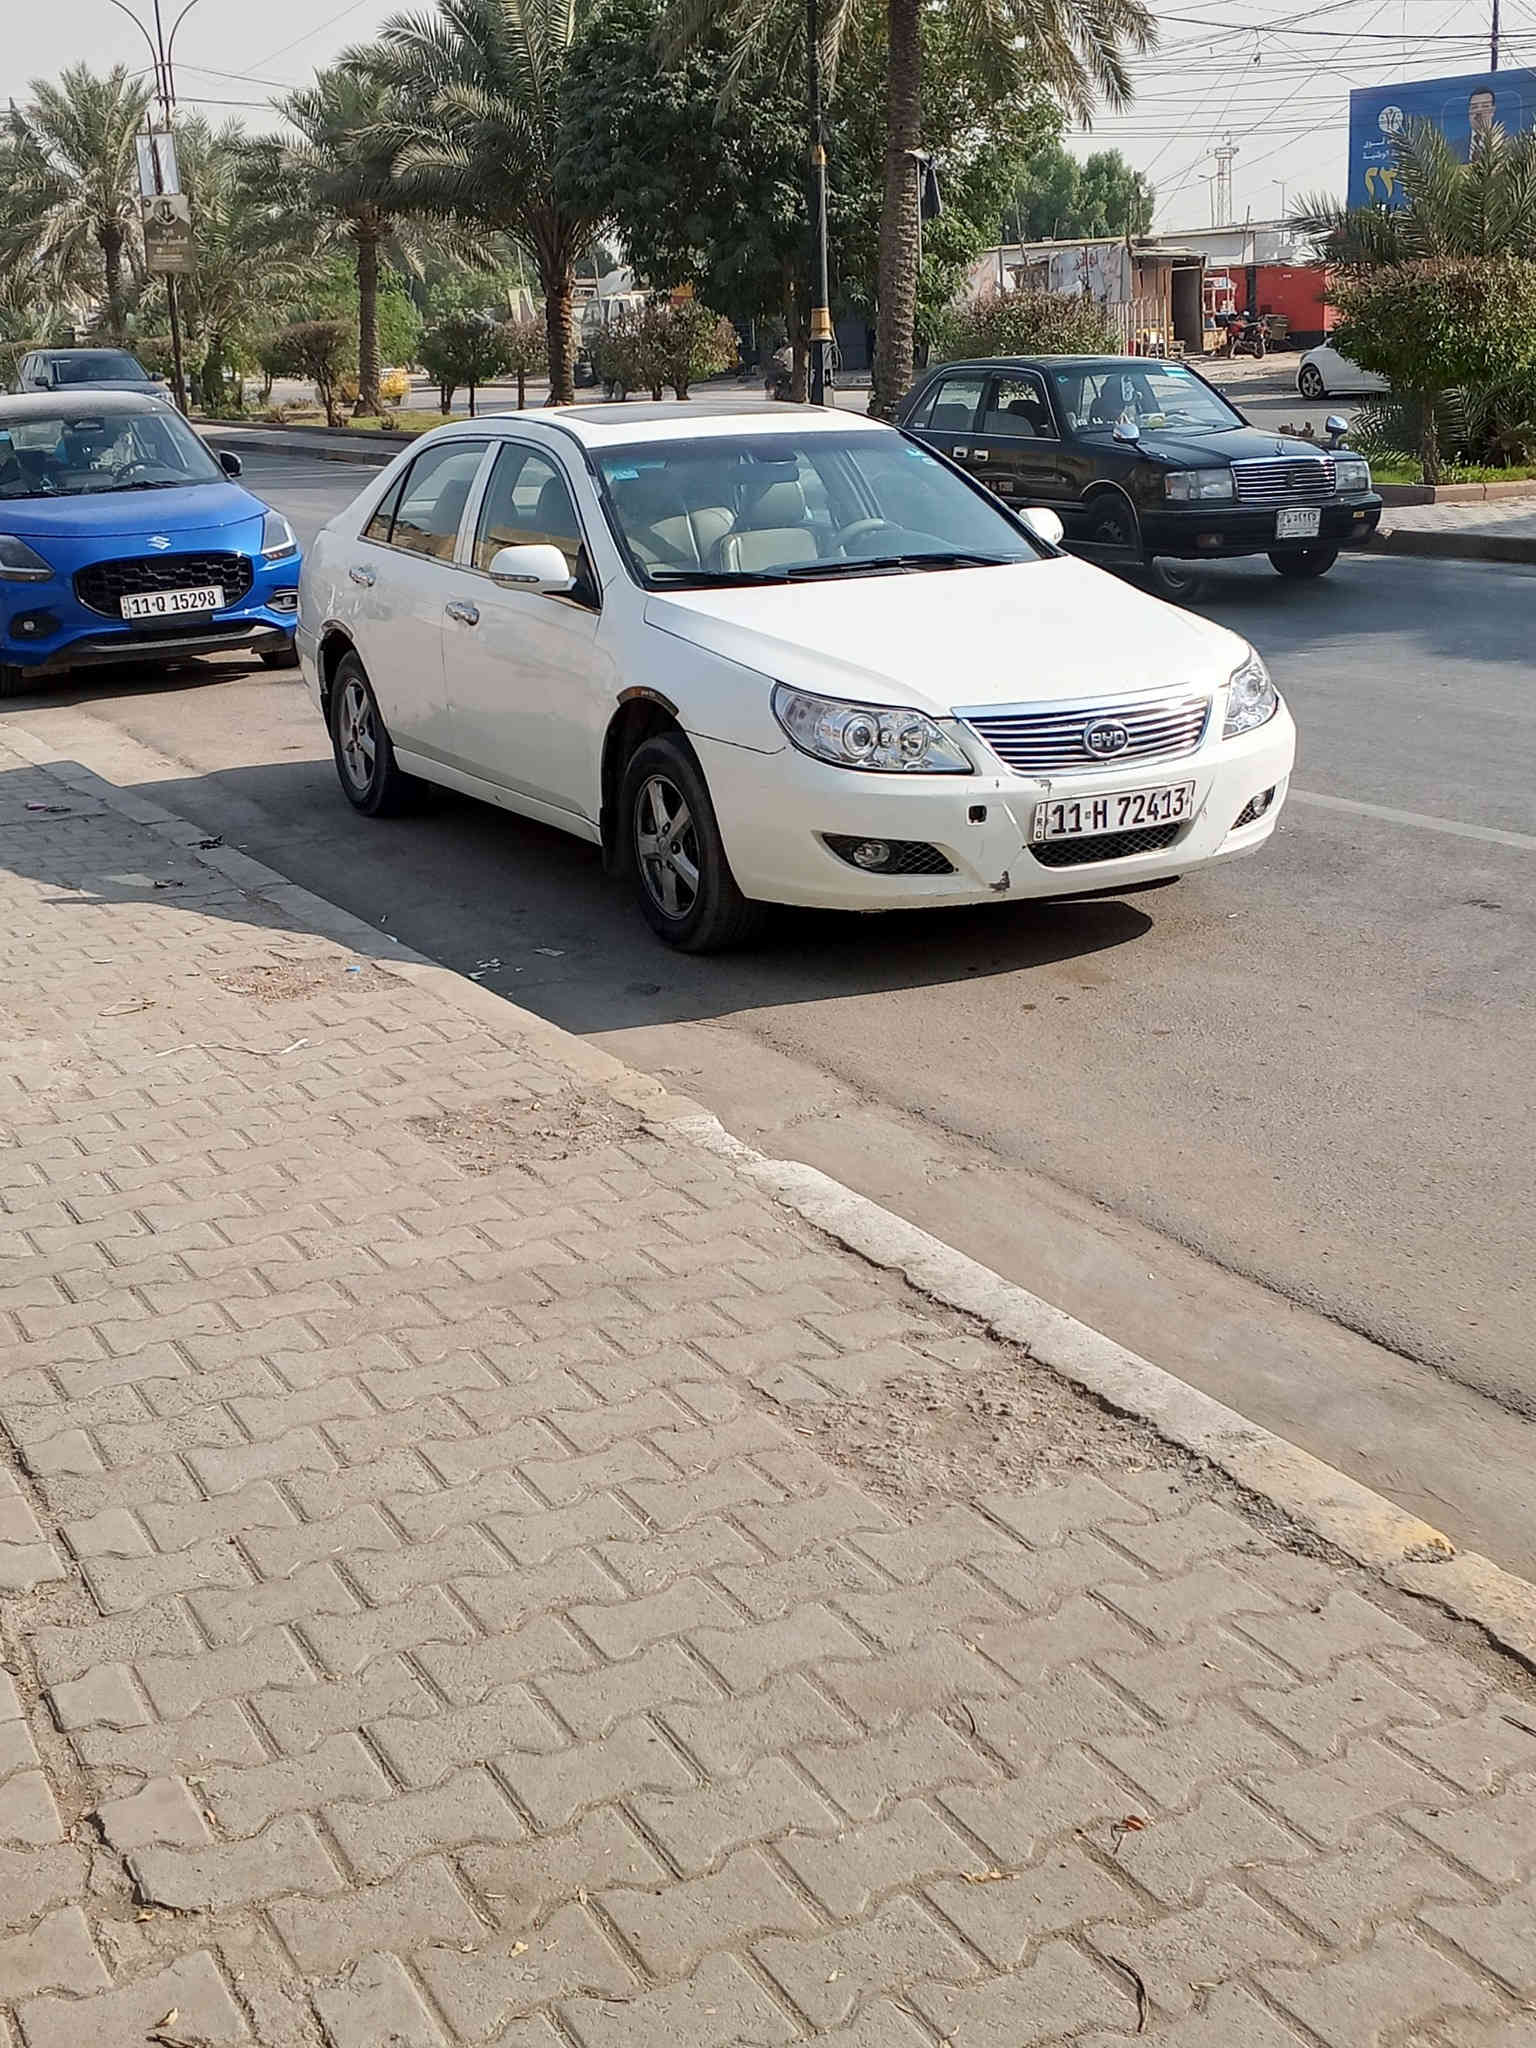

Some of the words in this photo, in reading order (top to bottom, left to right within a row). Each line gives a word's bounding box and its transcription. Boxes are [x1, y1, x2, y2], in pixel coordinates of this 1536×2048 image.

[170, 590, 216, 611] 15298
[1091, 730, 1126, 748] BYD
[1117, 787, 1186, 826] 72413
